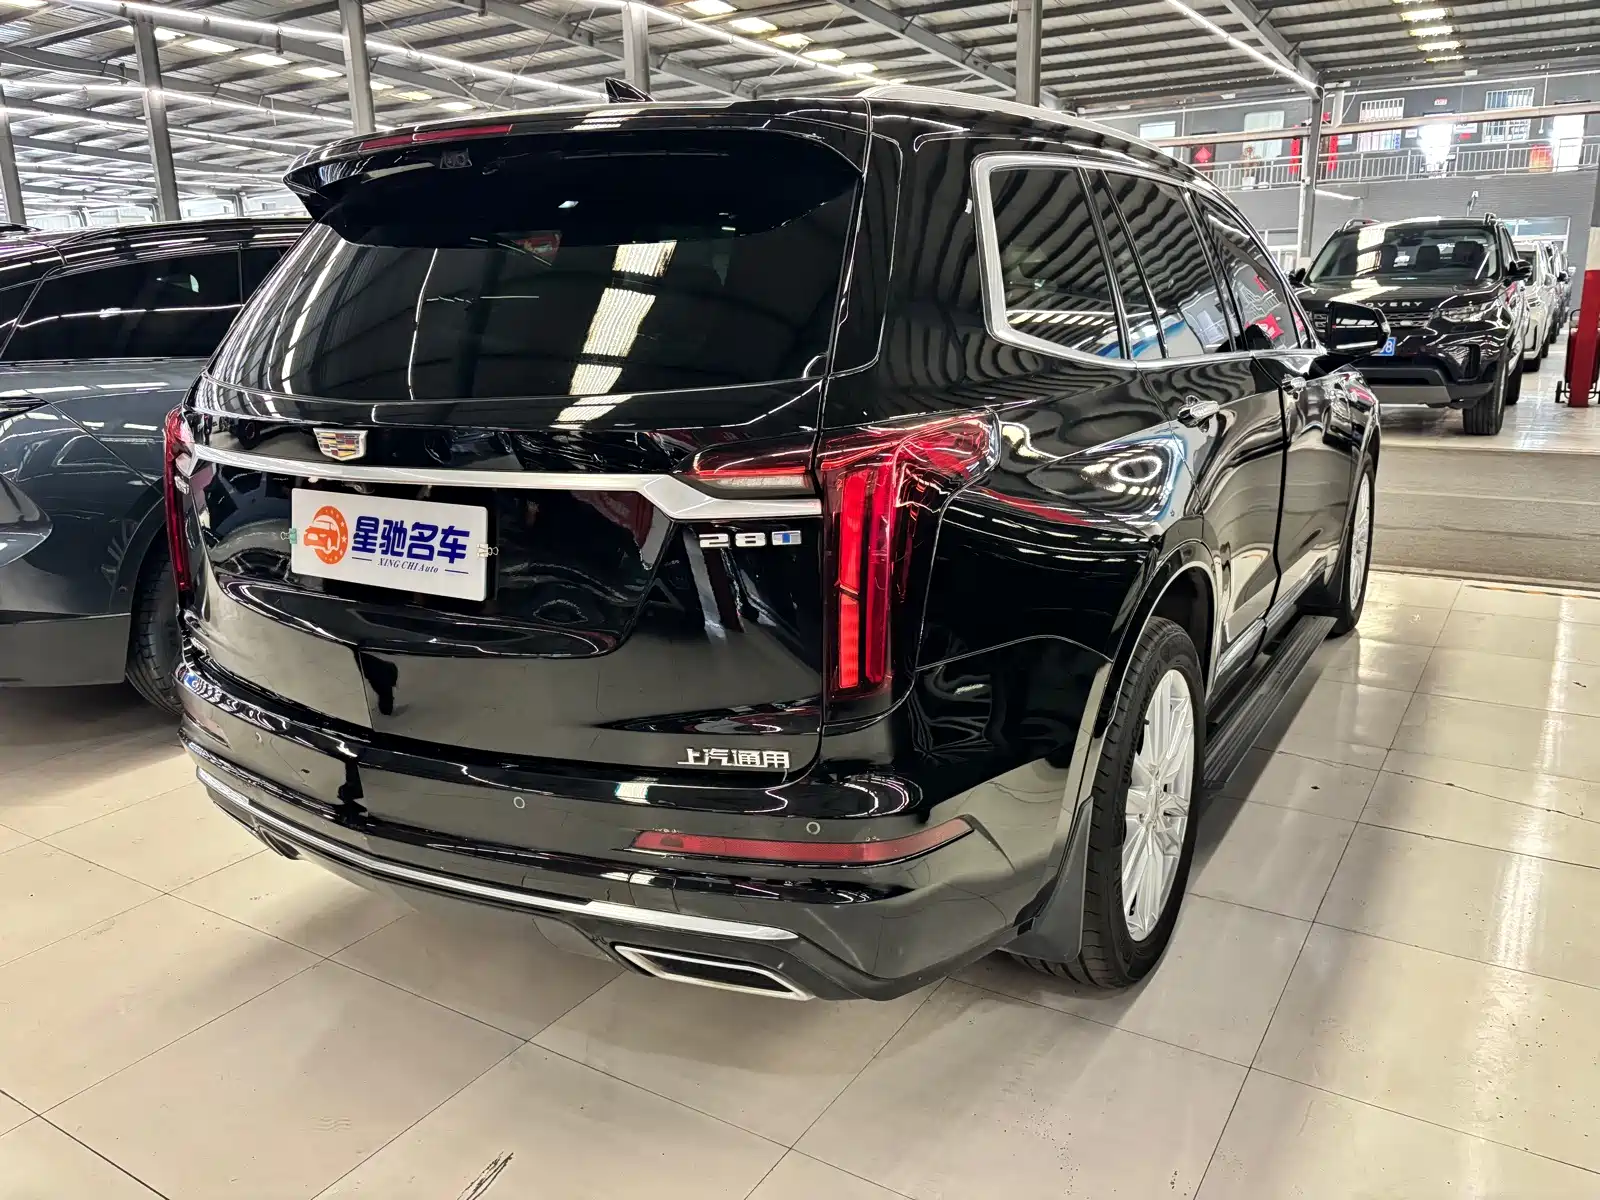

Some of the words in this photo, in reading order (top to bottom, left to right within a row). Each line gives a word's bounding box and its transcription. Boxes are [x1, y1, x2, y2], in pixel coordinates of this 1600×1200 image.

[351, 515, 471, 564] 星驰名车
[377, 557, 401, 568] XING
[401, 560, 420, 571] CHI
[419, 563, 439, 574] Auto
[677, 748, 790, 769] 上汽通用
